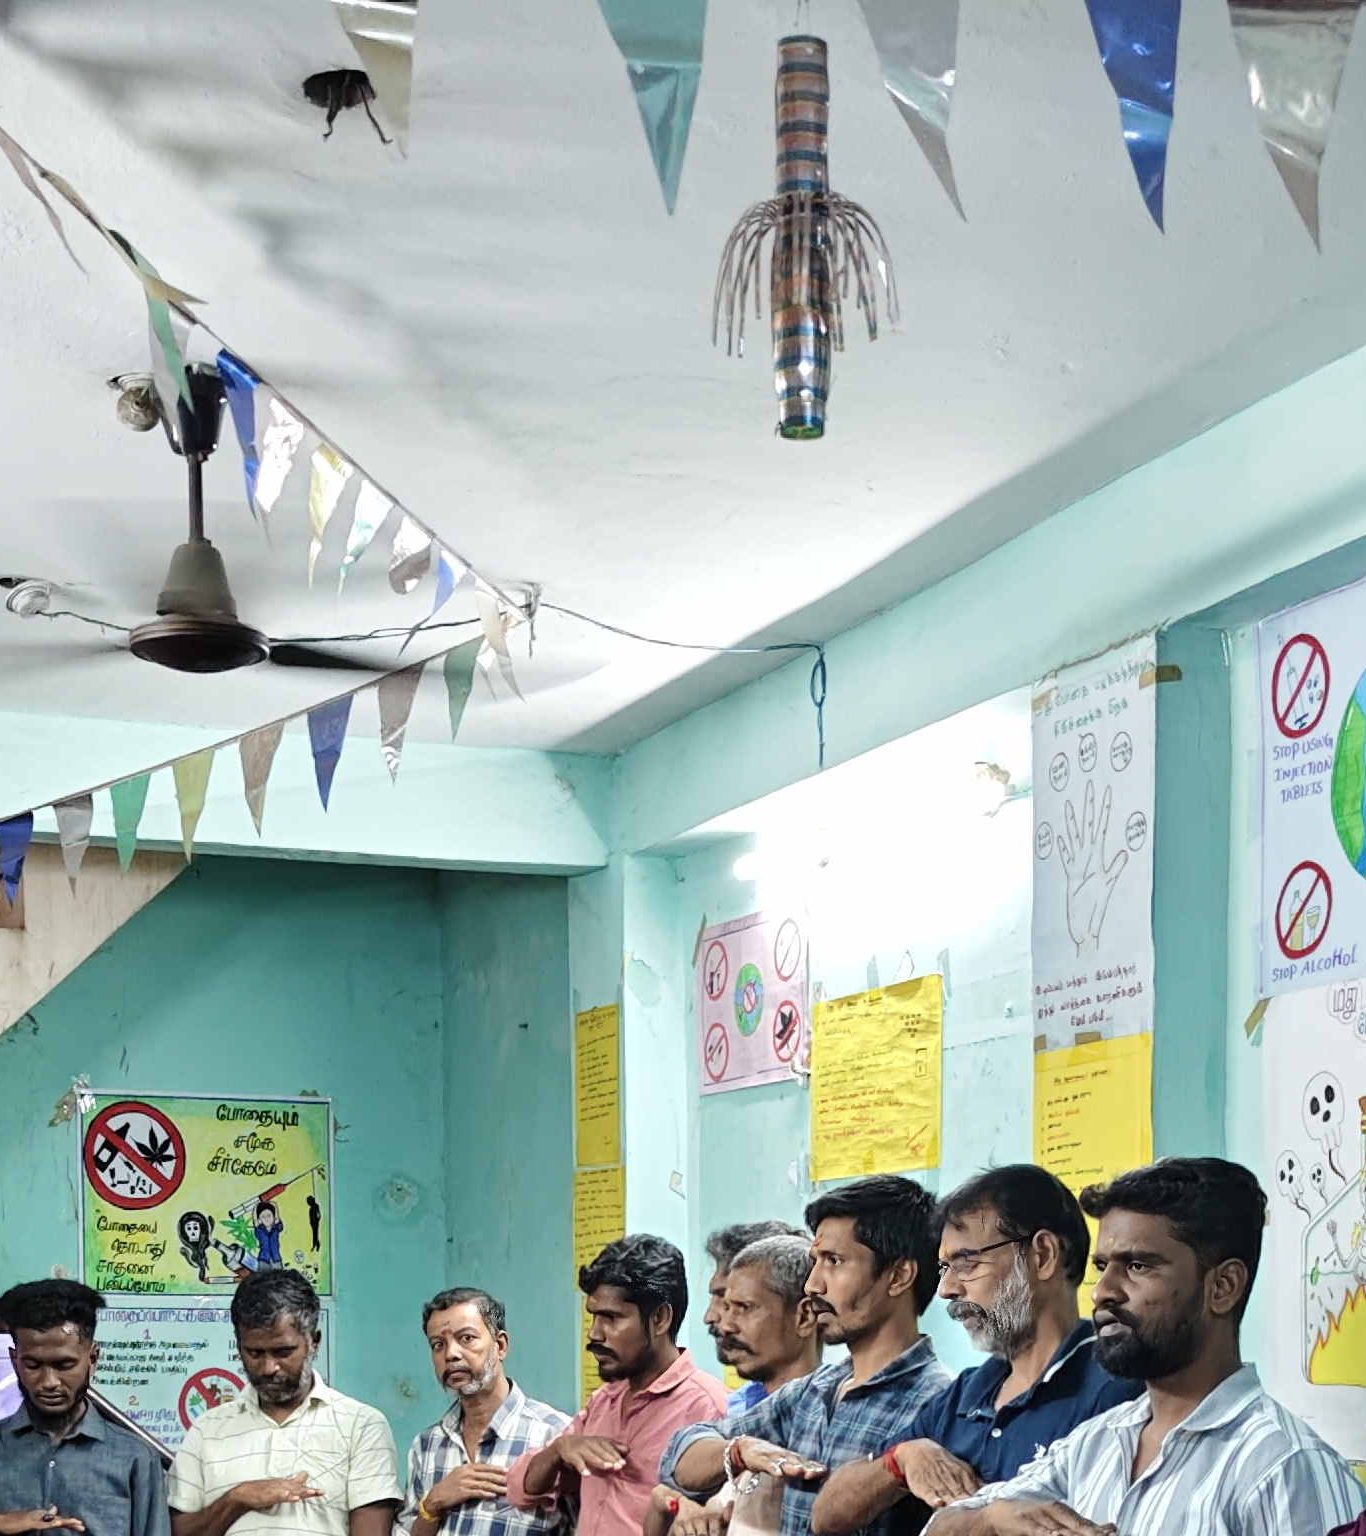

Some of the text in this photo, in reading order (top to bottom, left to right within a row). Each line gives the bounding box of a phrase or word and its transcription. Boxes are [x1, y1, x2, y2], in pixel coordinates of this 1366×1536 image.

[1272, 743, 1300, 761] STOP
[1275, 757, 1333, 783] INJECTION
[1272, 962, 1296, 982] STOP
[216, 1103, 300, 1131] போதையும்
[207, 1146, 278, 1177] சீர்கேடும்
